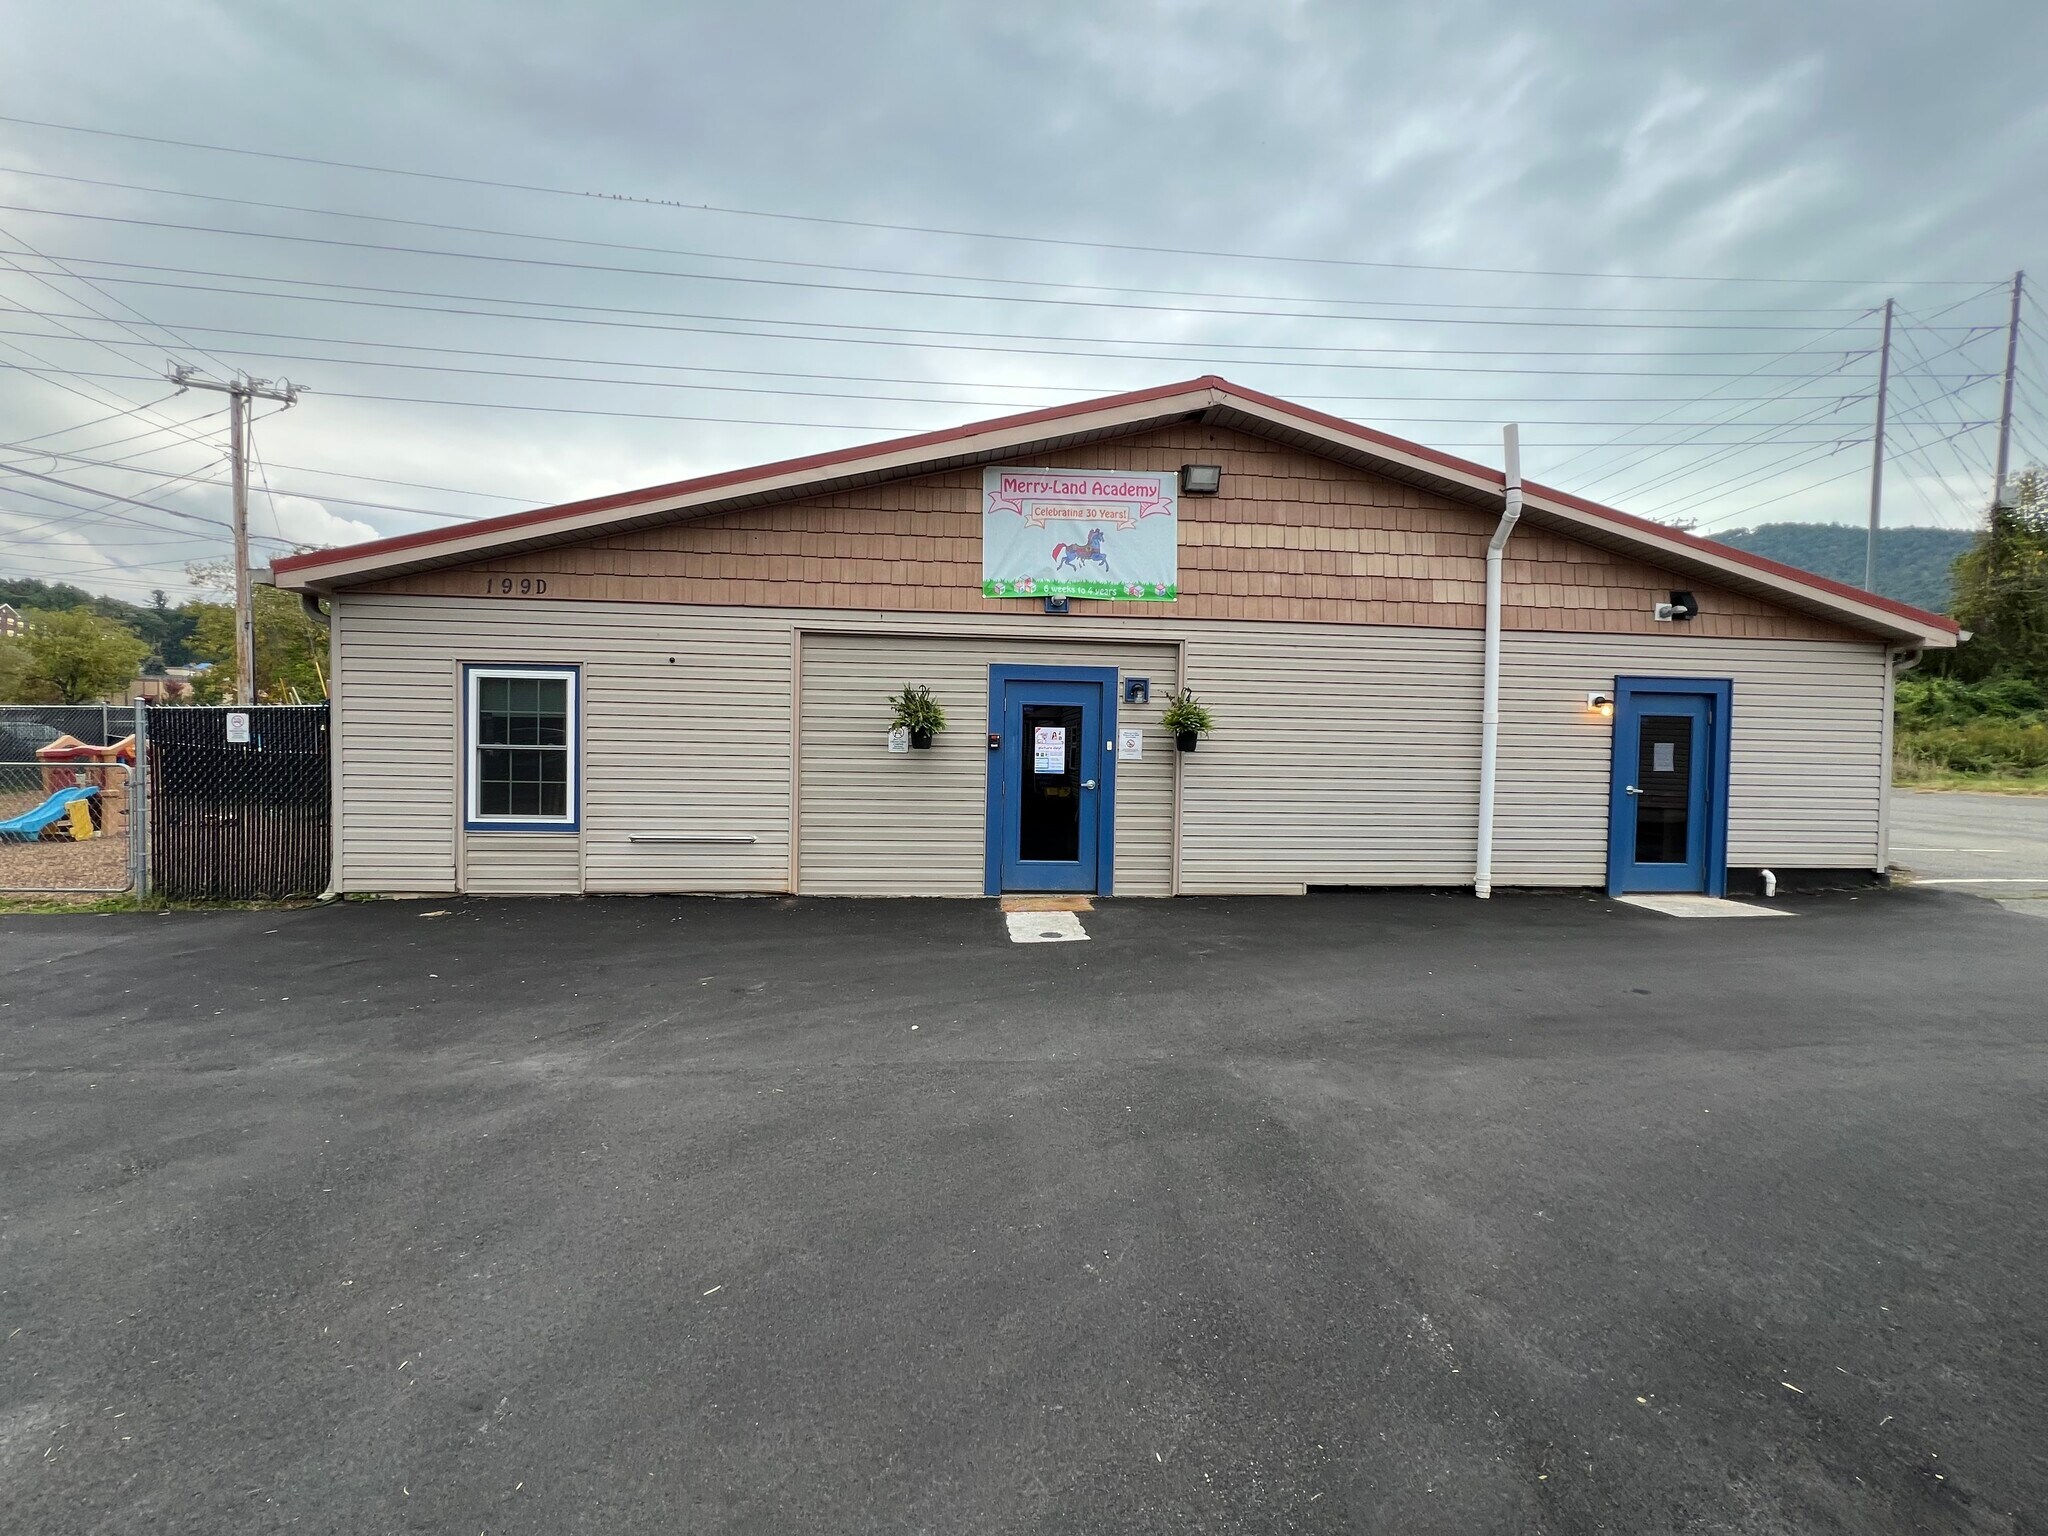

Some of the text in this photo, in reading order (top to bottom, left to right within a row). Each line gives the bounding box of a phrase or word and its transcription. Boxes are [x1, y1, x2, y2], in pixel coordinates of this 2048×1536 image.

[1003, 478, 1158, 497] Merry-Land Academy
[1034, 507, 1127, 519] Celebrating 30 Years!
[486, 577, 547, 595] 199D
[1043, 584, 1118, 597] 6 weeks to 4 years
